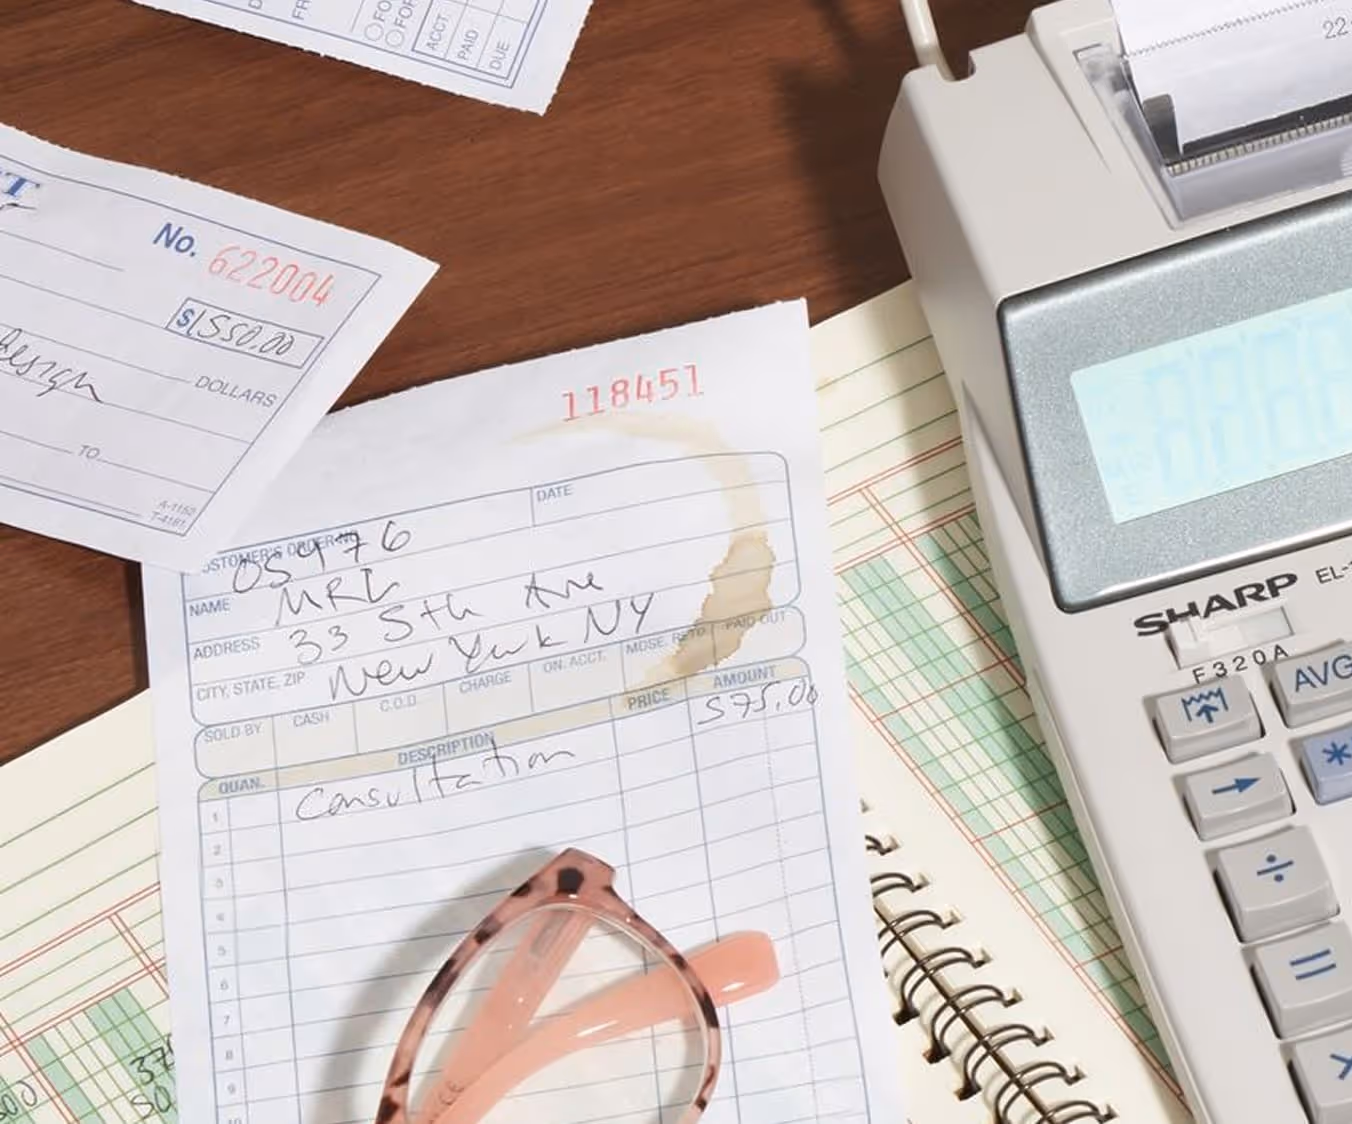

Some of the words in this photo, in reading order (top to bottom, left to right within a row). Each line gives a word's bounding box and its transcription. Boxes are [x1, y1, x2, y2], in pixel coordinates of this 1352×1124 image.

[426, 14, 450, 51] ACCT
[457, 29, 480, 60] PAID
[488, 40, 511, 71] DUE
[153, 222, 196, 257] No.
[208, 245, 335, 309] 622004
[195, 374, 278, 408] DOLLARS
[560, 363, 705, 422] 118451
[78, 444, 101, 460] TO
[536, 484, 573, 502] DATE
[189, 598, 232, 618] NAME
[584, 592, 654, 644] NY
[758, 610, 788, 626] OUT
[1133, 572, 1299, 638] SHARP
[193, 635, 261, 661] ADDRESS
[283, 670, 306, 686] ZIP
[458, 670, 513, 696] CHARGE
[712, 664, 778, 690] AMOUNT
[626, 687, 671, 711] PRICE
[292, 710, 331, 728] CASH
[203, 725, 242, 744] SOLD
[244, 722, 263, 736] BY
[396, 730, 496, 767] DESCRIPTION
[217, 776, 266, 795] QUAN.
